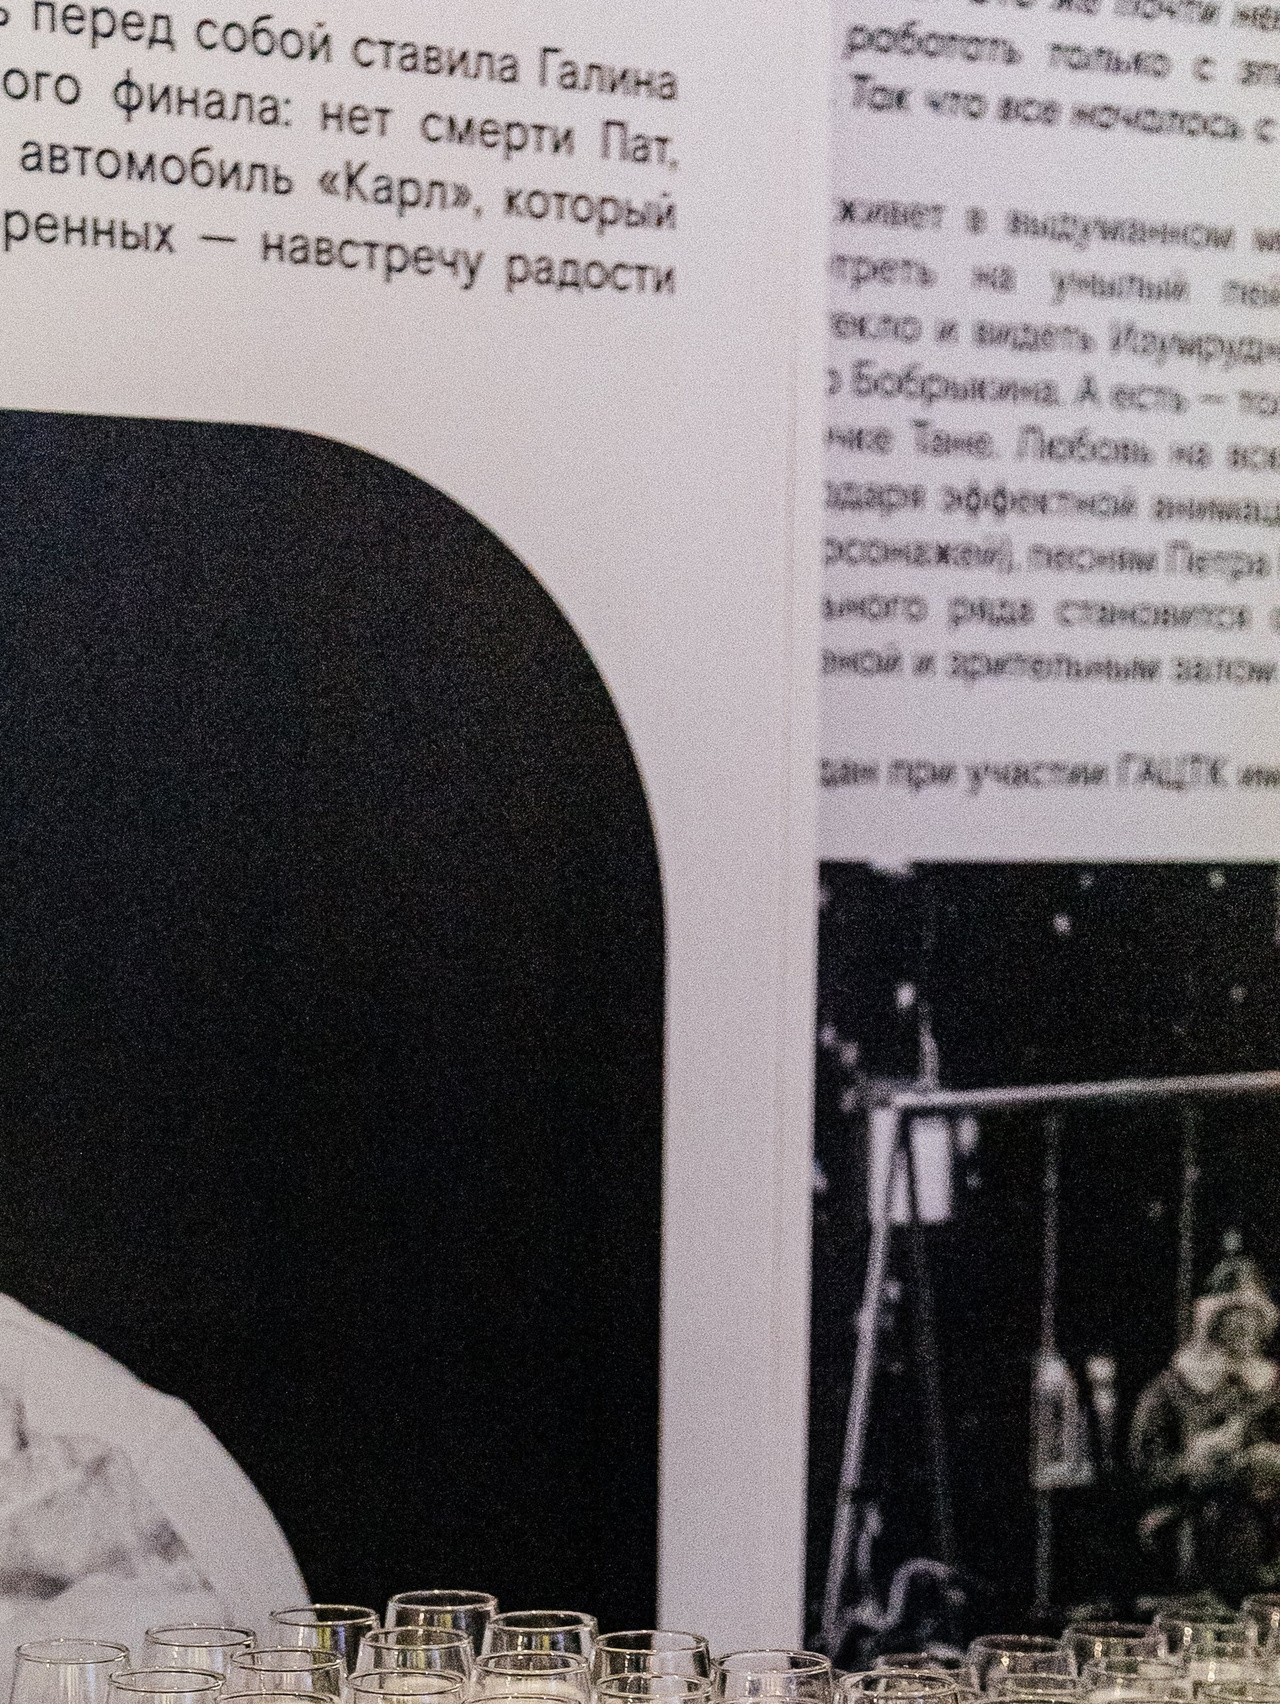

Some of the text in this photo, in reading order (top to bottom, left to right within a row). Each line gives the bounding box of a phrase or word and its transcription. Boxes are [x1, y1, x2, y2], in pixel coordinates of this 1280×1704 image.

[33, 0, 176, 52] перед
[195, 14, 331, 62] собой
[351, 36, 519, 84] ставила
[539, 46, 677, 101] Галина
[112, 69, 291, 127] финала:
[321, 102, 392, 136] нет
[420, 112, 574, 160] смерти
[601, 119, 677, 169] Пат,
[20, 140, 293, 196] автомобиль
[318, 160, 482, 218] «Карл»,
[504, 189, 676, 236] который
[262, 232, 484, 291] навстречу
[506, 254, 674, 293] радости
